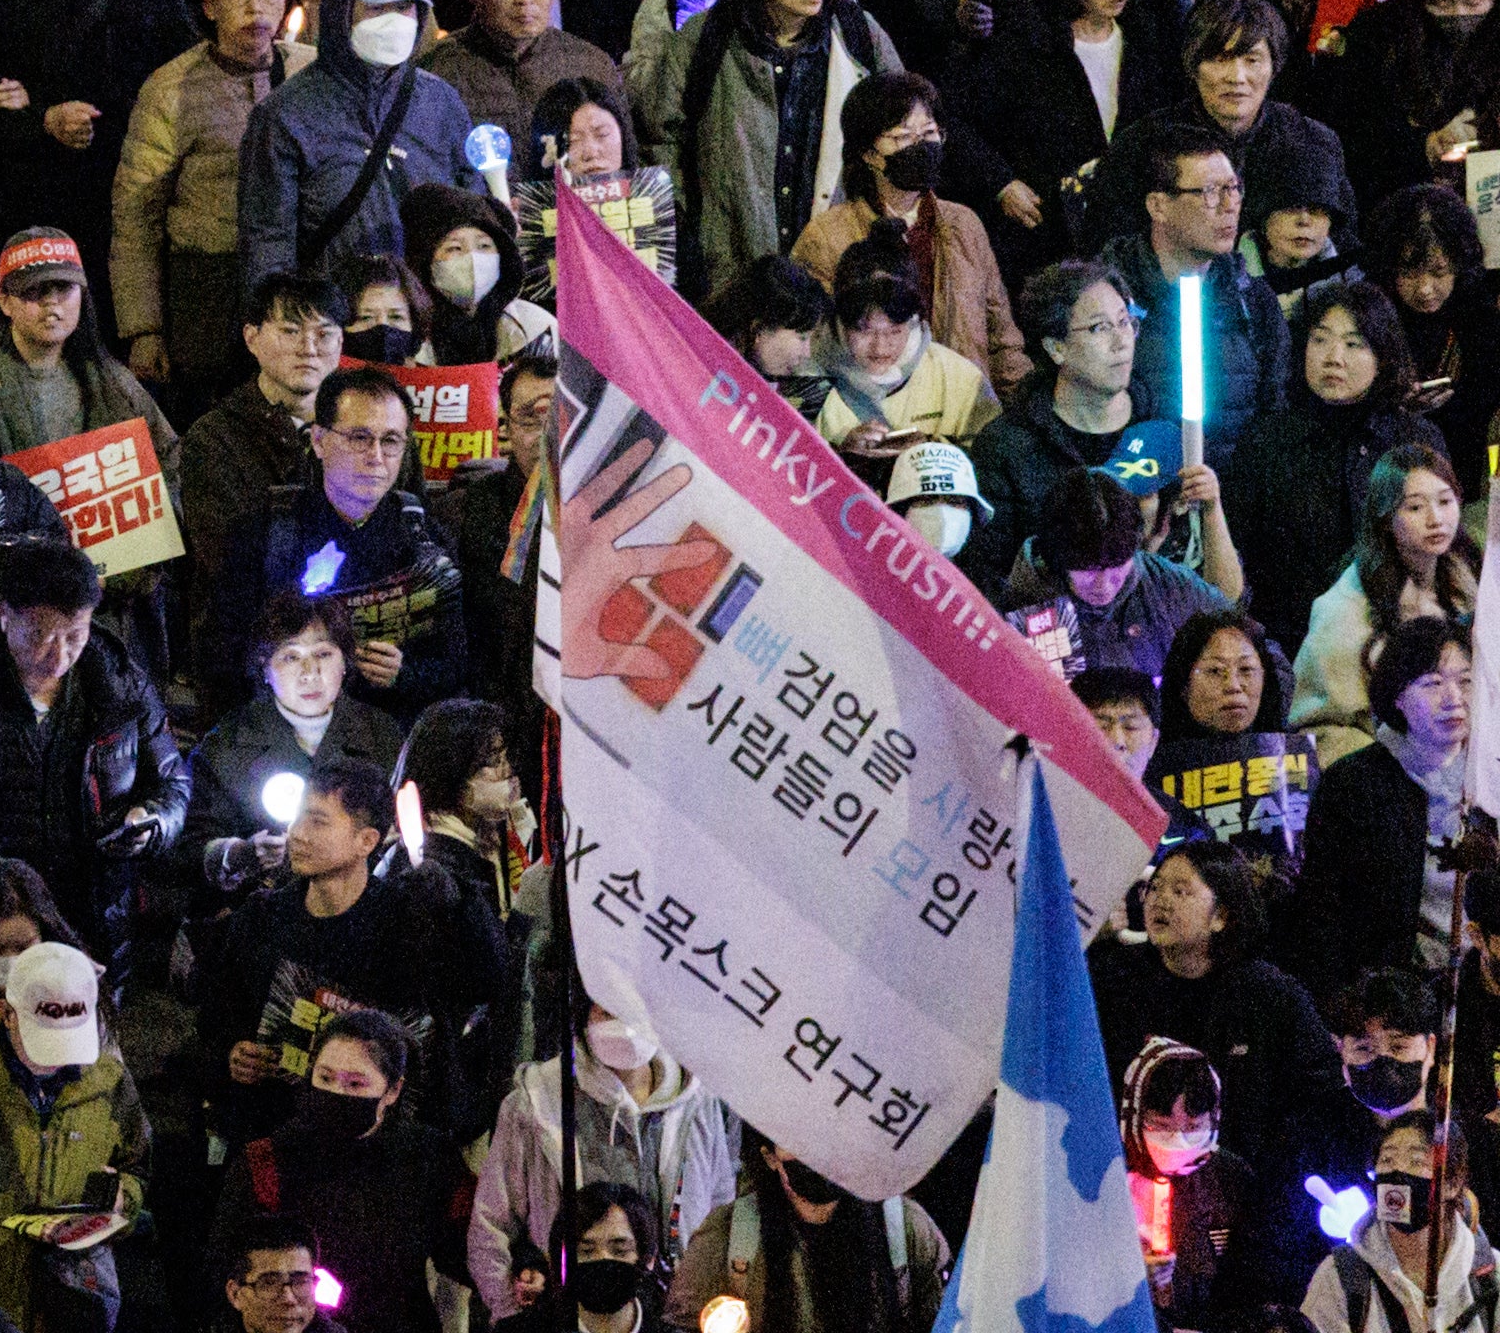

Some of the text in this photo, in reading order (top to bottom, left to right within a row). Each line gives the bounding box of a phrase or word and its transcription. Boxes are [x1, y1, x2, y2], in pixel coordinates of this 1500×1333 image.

[702, 369, 837, 504] Pinky
[686, 680, 979, 941] 사람들의 모임
[591, 866, 933, 1154] 손목스크 연구회
